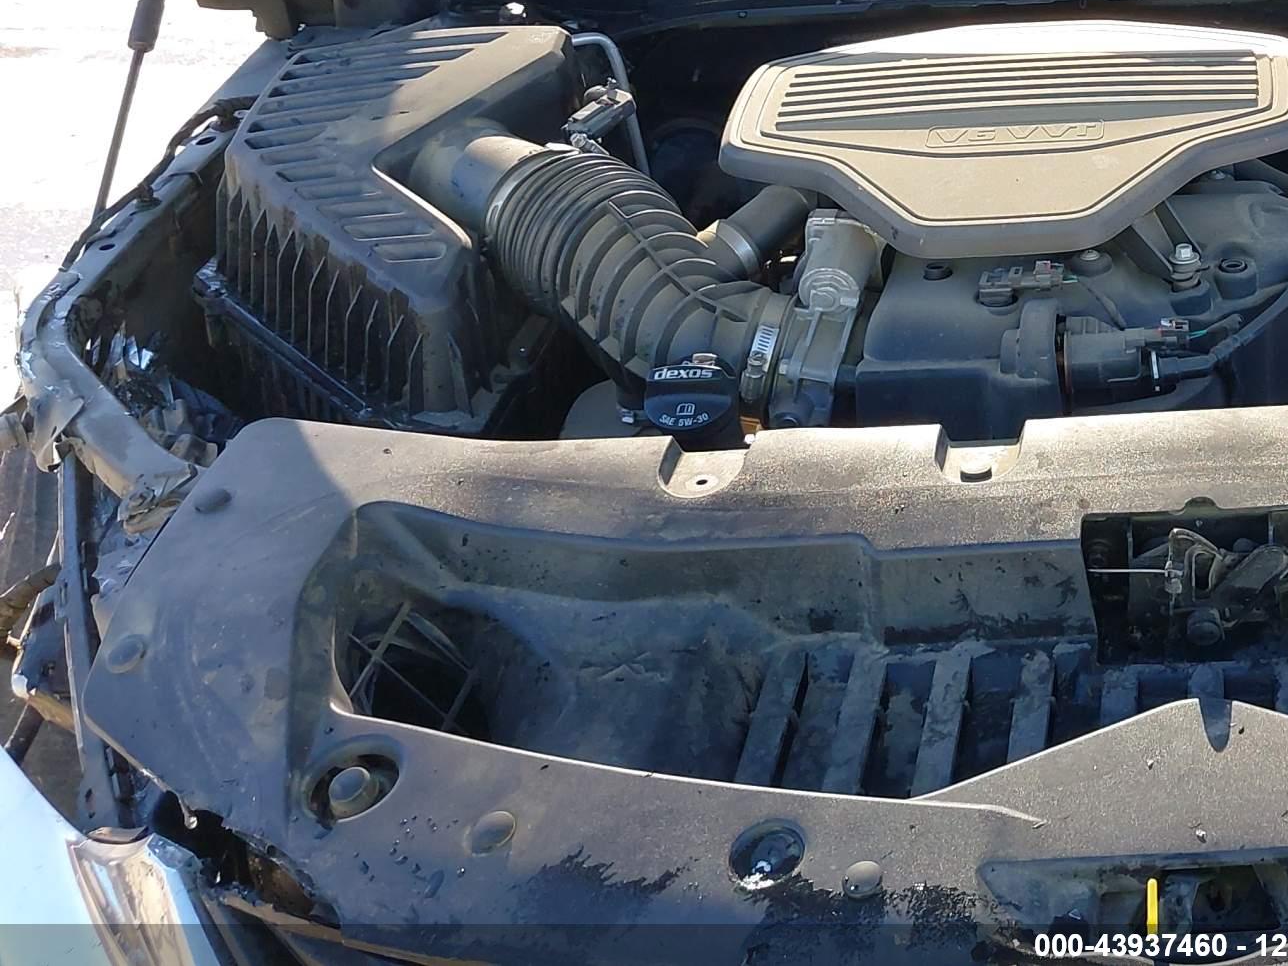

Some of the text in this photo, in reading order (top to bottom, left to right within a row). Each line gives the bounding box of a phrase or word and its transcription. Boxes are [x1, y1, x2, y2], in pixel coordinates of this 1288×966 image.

[935, 123, 1097, 144] V6 VVT
[654, 368, 713, 380] dexos
[659, 413, 709, 427] SAE 5W-30
